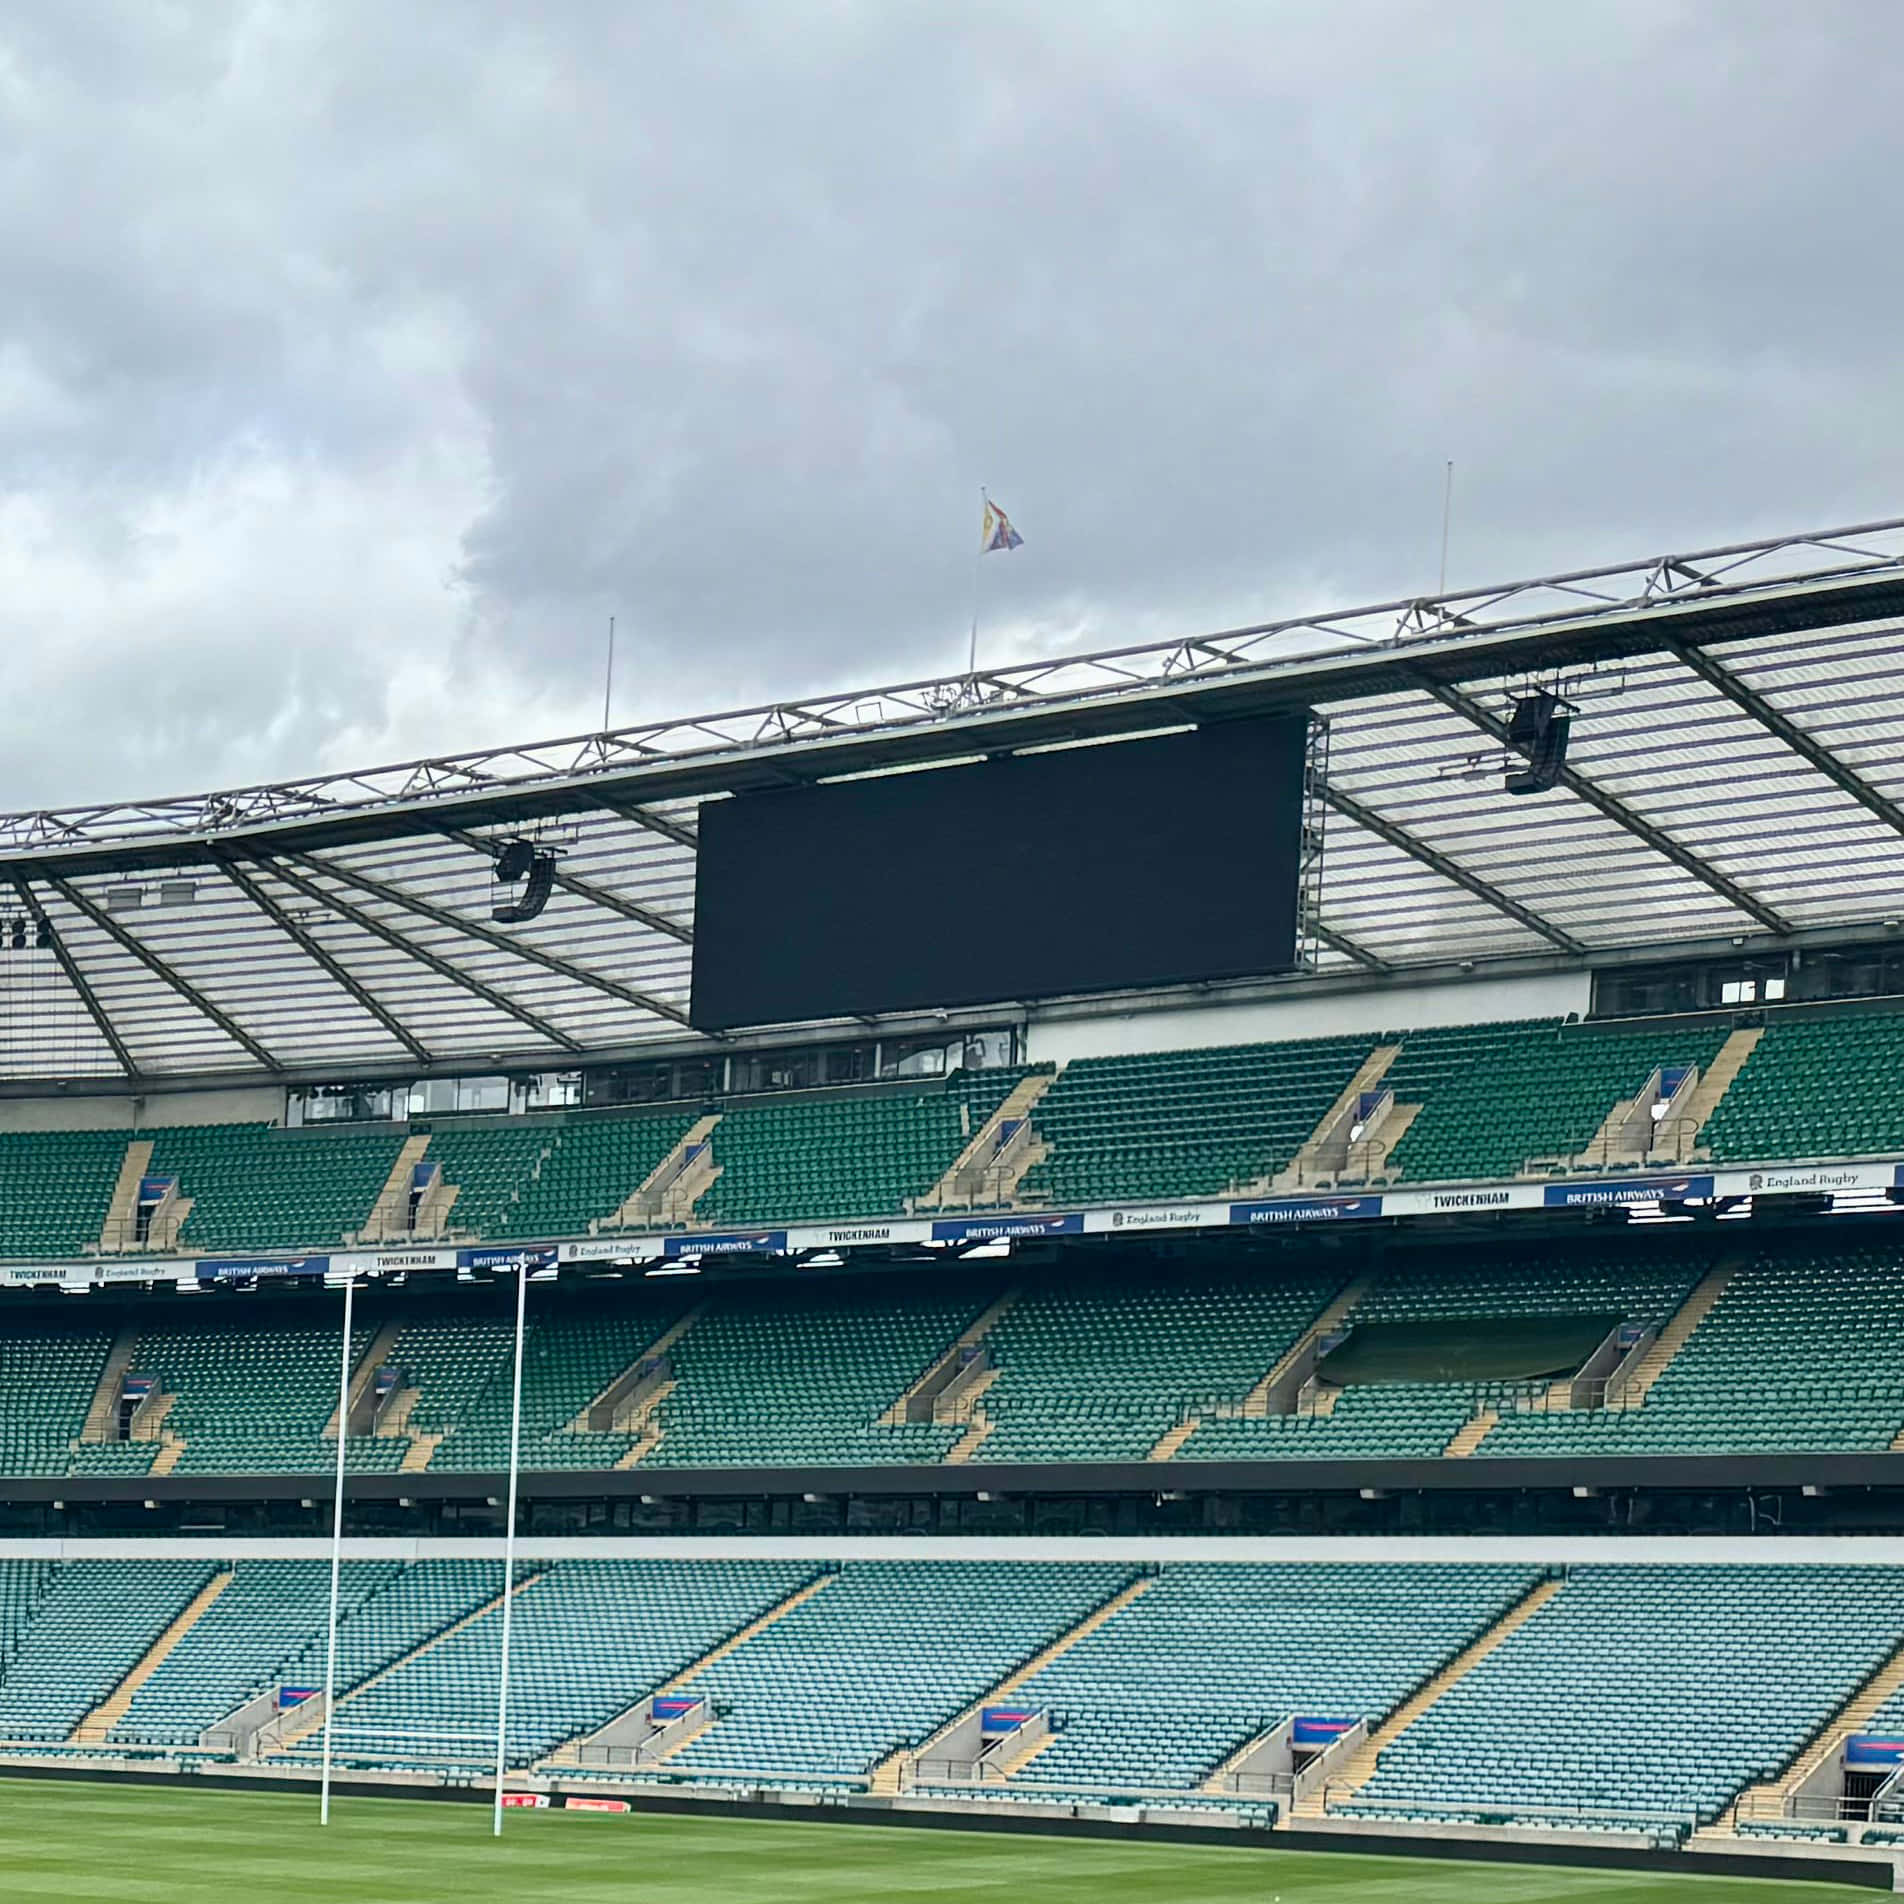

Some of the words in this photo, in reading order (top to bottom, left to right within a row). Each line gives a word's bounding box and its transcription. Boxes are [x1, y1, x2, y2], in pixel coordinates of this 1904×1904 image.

[1767, 1174, 1817, 1188] England
[1819, 1171, 1859, 1186] Rugby
[1434, 1193, 1510, 1209] TWICKENHAM
[1566, 1191, 1614, 1205] BRITISH
[1615, 1188, 1665, 1202] AIRWAYS
[1127, 1214, 1167, 1225] England
[1169, 1213, 1201, 1224] Rugby
[1250, 1210, 1292, 1224] BRITISH
[1294, 1207, 1339, 1221] AIRWAYS
[829, 1228, 890, 1241] TWICKENHAM
[965, 1227, 1004, 1238] BRITISH
[1006, 1223, 1046, 1234] AIRWAYS
[580, 1245, 614, 1256] England
[615, 1244, 641, 1255] Rugby
[680, 1244, 715, 1255] BRITISH
[716, 1241, 753, 1252] AIRWAYS
[376, 1255, 436, 1267] TWICKENHAM
[218, 1267, 251, 1276] BRITISH
[253, 1265, 289, 1275] AIRWAYS
